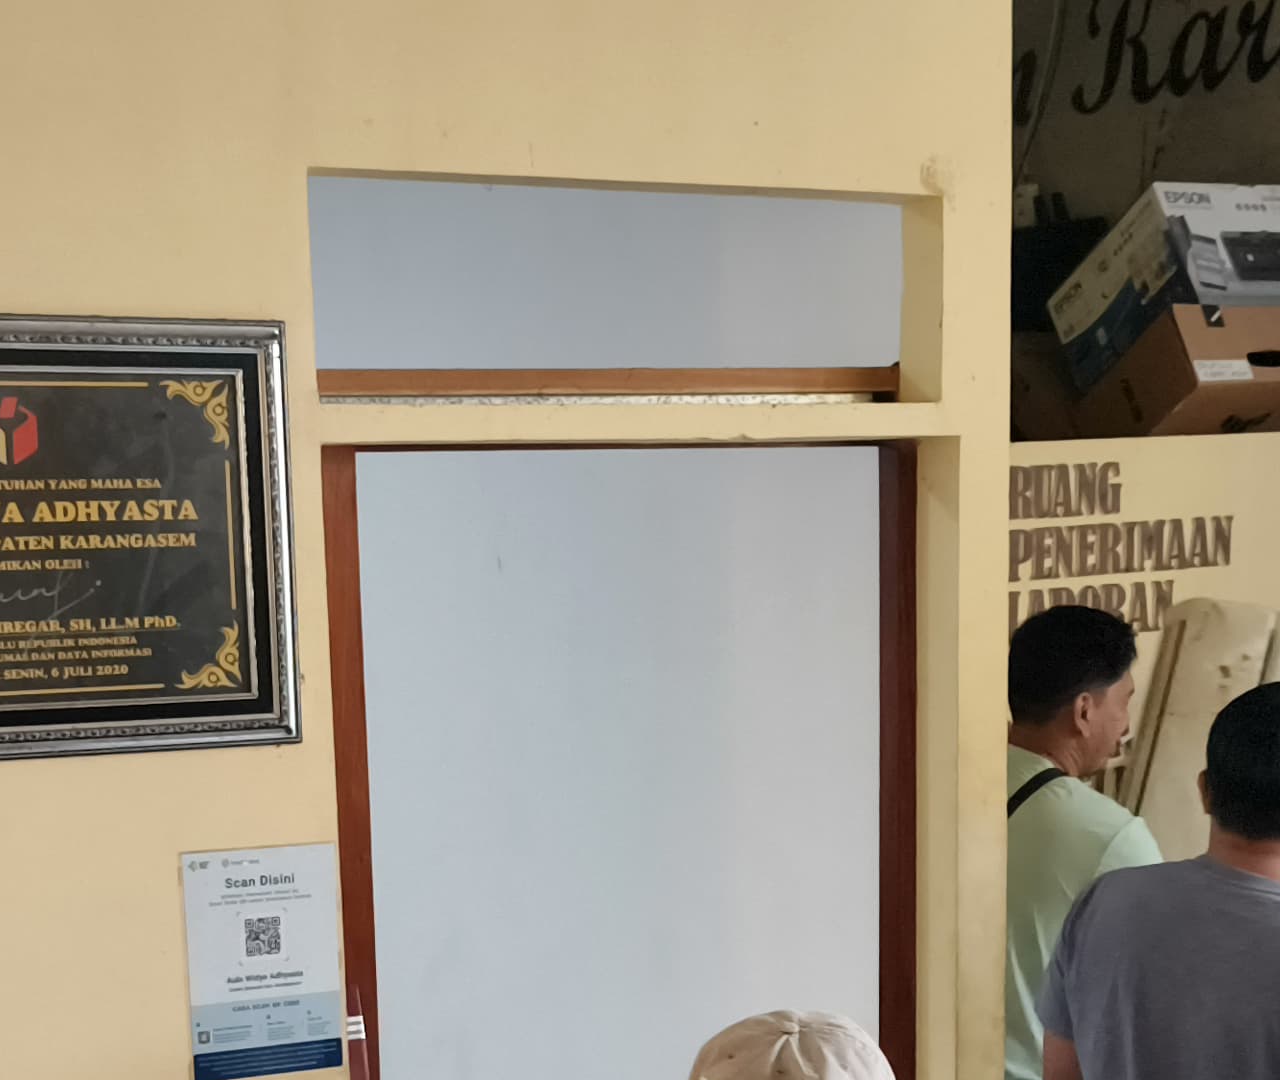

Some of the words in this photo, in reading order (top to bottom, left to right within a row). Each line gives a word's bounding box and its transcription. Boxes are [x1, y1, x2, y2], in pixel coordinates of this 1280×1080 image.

[1164, 191, 1211, 205] EPSON
[48, 479, 88, 490] YANG
[91, 478, 133, 490] MAHA
[136, 478, 161, 489] ESA
[1009, 462, 1122, 520] RUANG
[32, 499, 199, 523] ADHYASTA
[60, 532, 197, 550] KARANGASEM
[1009, 515, 1234, 582] PENERIMAAN
[45, 559, 82, 571] OLEH
[70, 618, 96, 632] SH,
[78, 636, 138, 647] INDONESIA
[31, 651, 56, 661] DAN
[58, 650, 89, 660] DATA
[51, 666, 60, 678] 6
[63, 665, 93, 680] JULI
[96, 664, 129, 676] 2020
[224, 877, 256, 889] Scan
[259, 872, 295, 887] Disini
